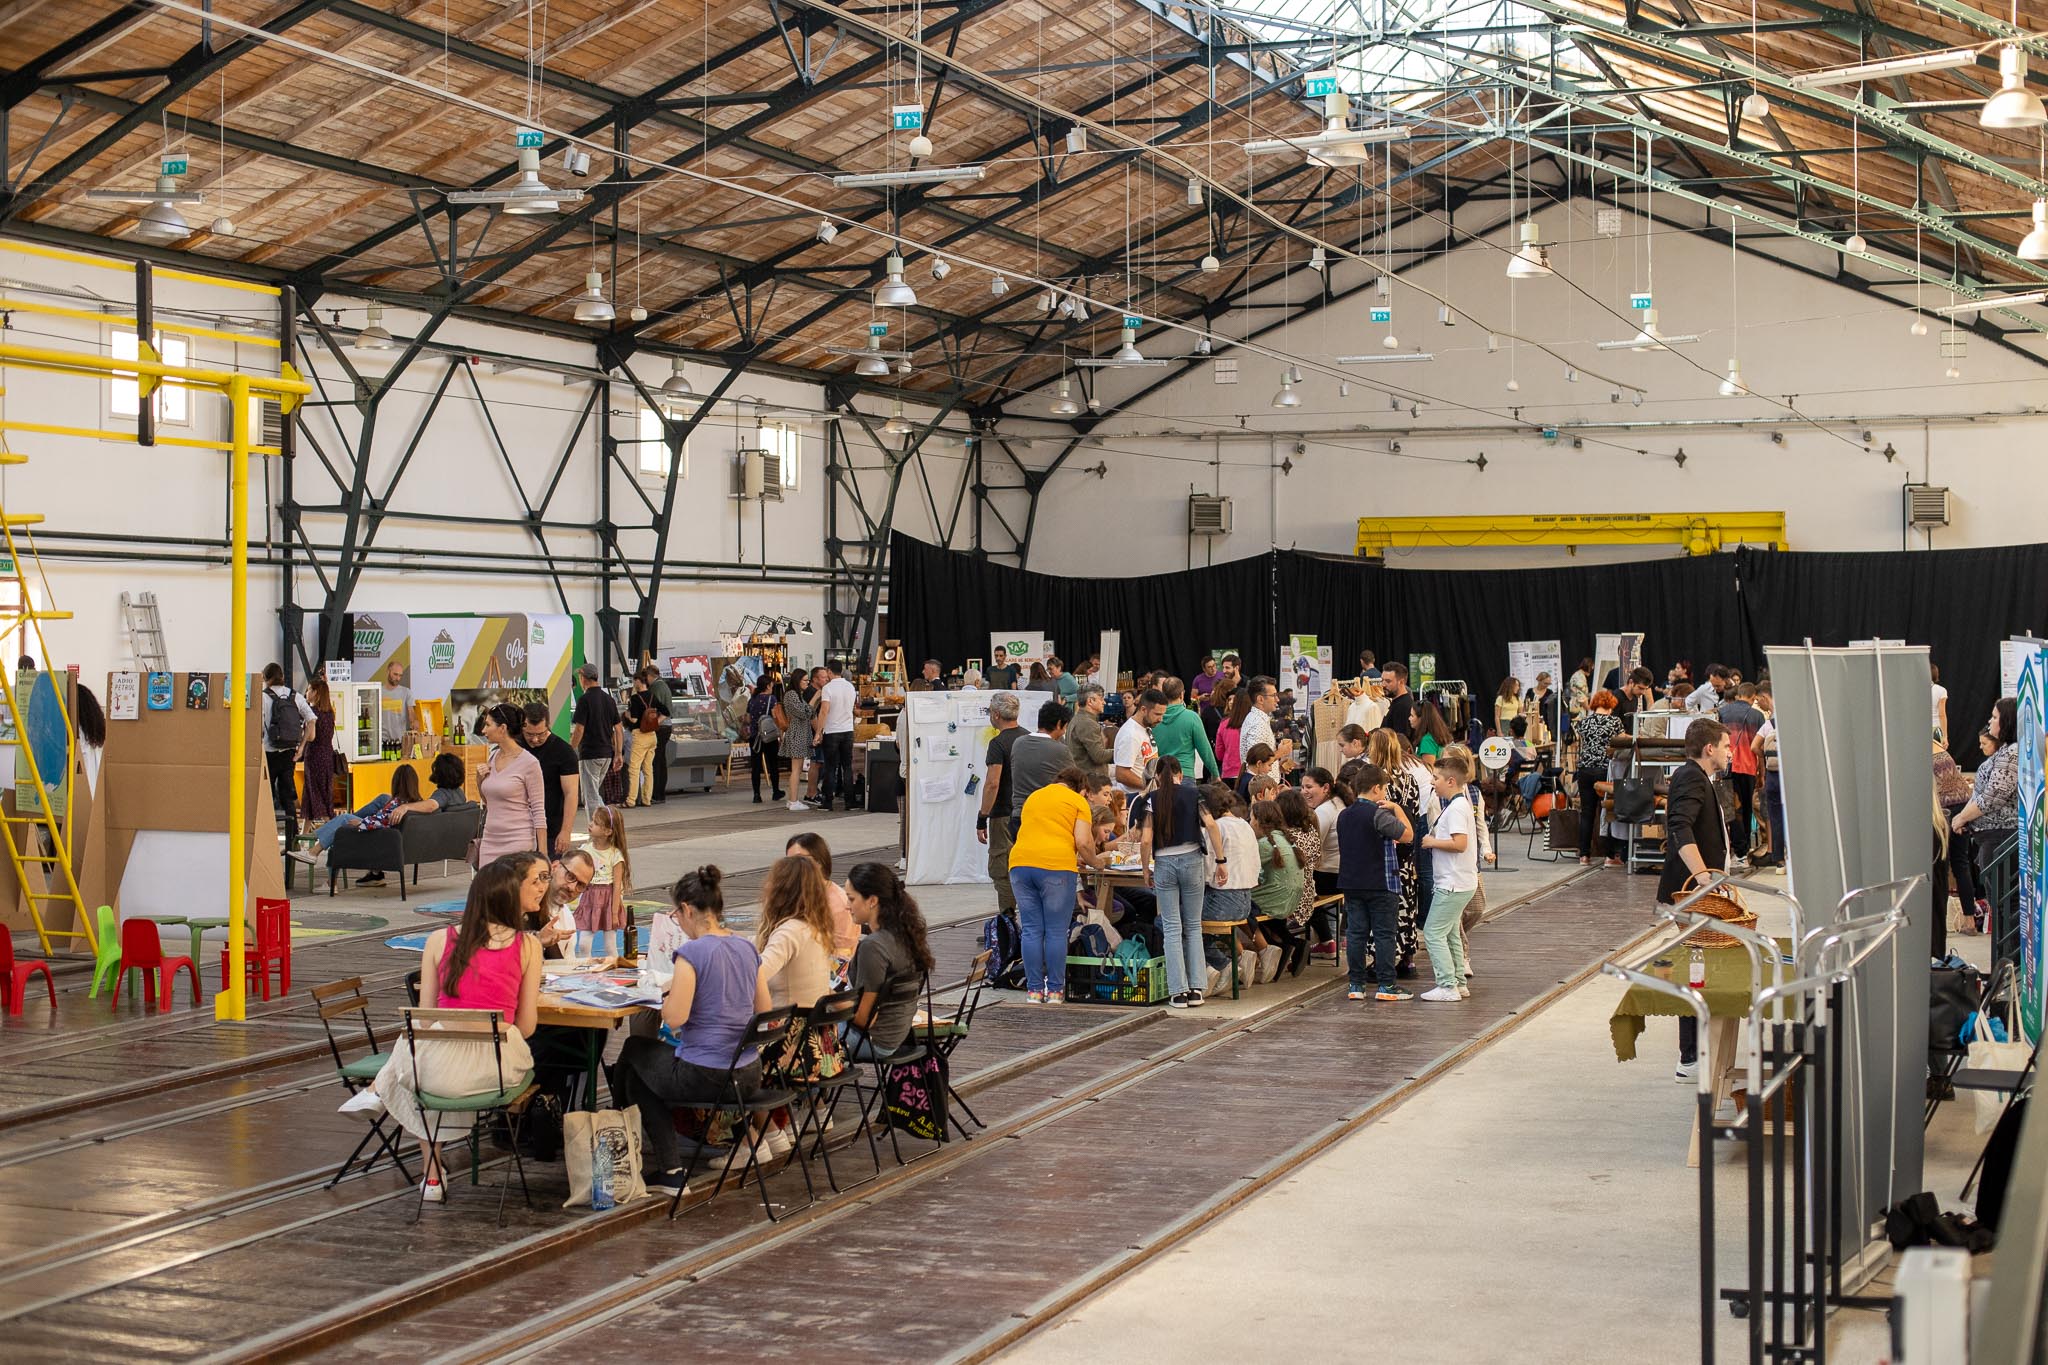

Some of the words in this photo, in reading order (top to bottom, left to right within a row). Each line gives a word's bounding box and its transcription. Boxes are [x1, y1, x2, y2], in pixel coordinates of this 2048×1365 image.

[354, 630, 384, 652] mag
[1009, 641, 1027, 652] YAYA
[429, 644, 455, 673] Smag
